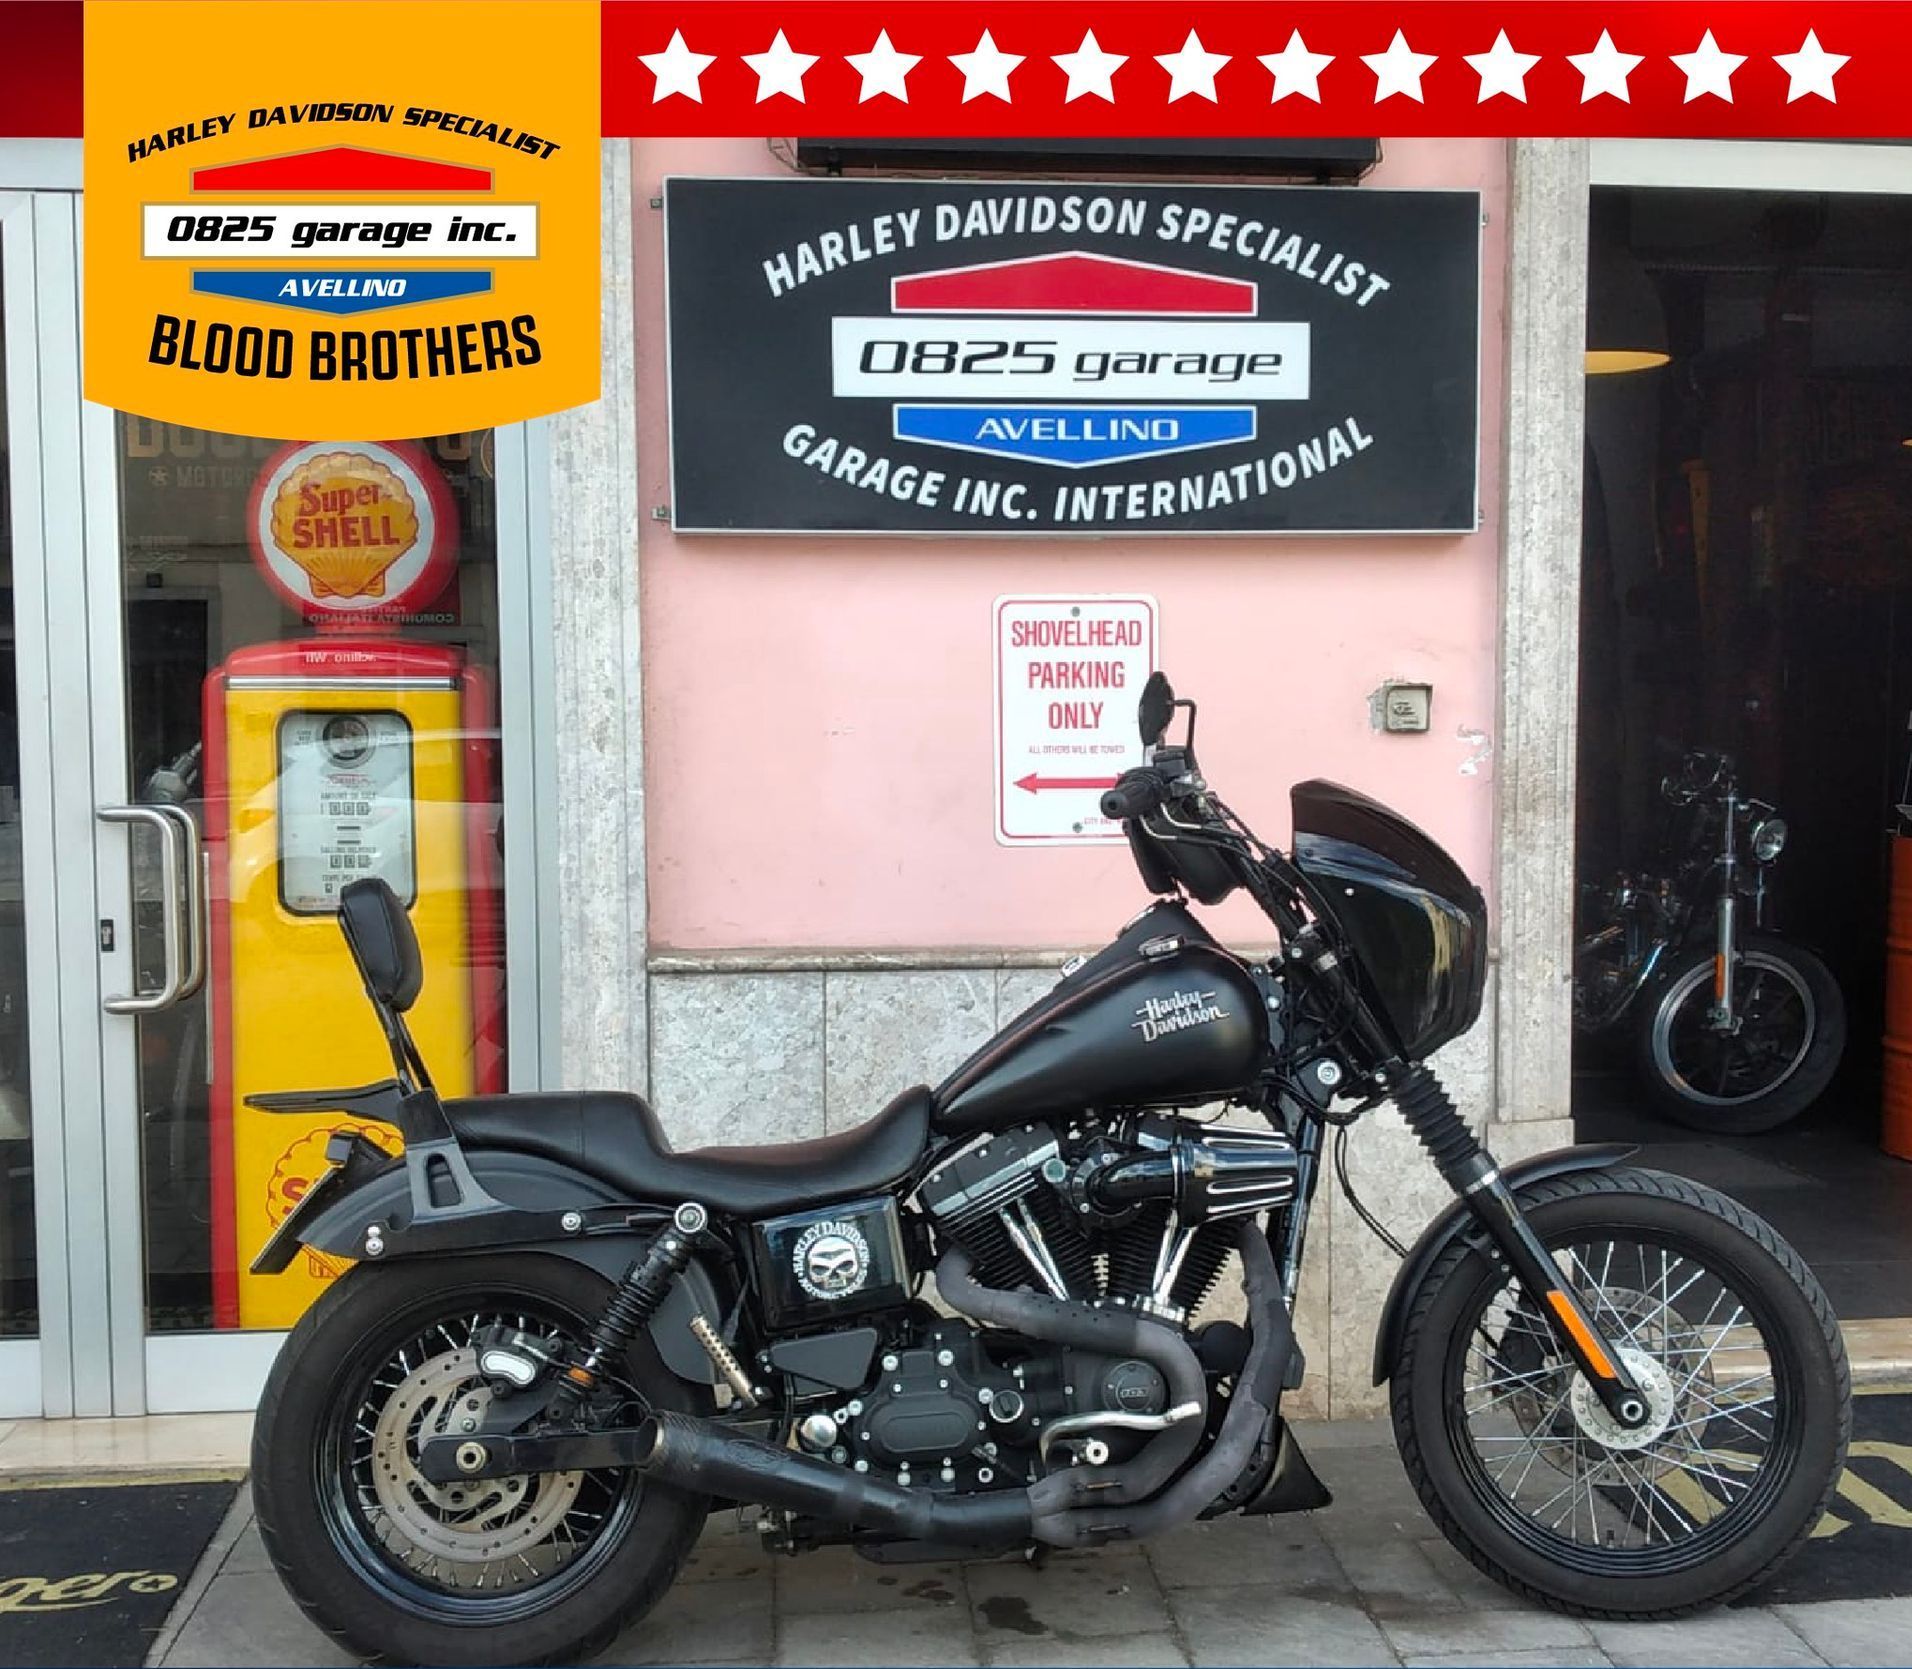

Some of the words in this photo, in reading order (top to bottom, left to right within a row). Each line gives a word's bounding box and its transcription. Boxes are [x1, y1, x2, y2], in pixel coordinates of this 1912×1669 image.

[763, 208, 921, 299] HARLEY
[936, 196, 1146, 241] DAVIDSON
[1157, 202, 1391, 309] SPECIALIST
[859, 340, 1057, 374] 0825
[1073, 352, 1282, 382] garage
[975, 418, 1179, 440] AVELLINO
[781, 424, 945, 507] GARAGE
[953, 478, 1037, 520] INC.
[1054, 414, 1374, 522] INTERNATIONAL
[299, 480, 381, 516] Super
[293, 515, 400, 548] SHELL
[1011, 620, 1143, 648] SHOVELHEAD
[1028, 661, 1125, 688] PARKING
[1049, 702, 1104, 729] ONLY
[1131, 1005, 1230, 1042] Davidson
